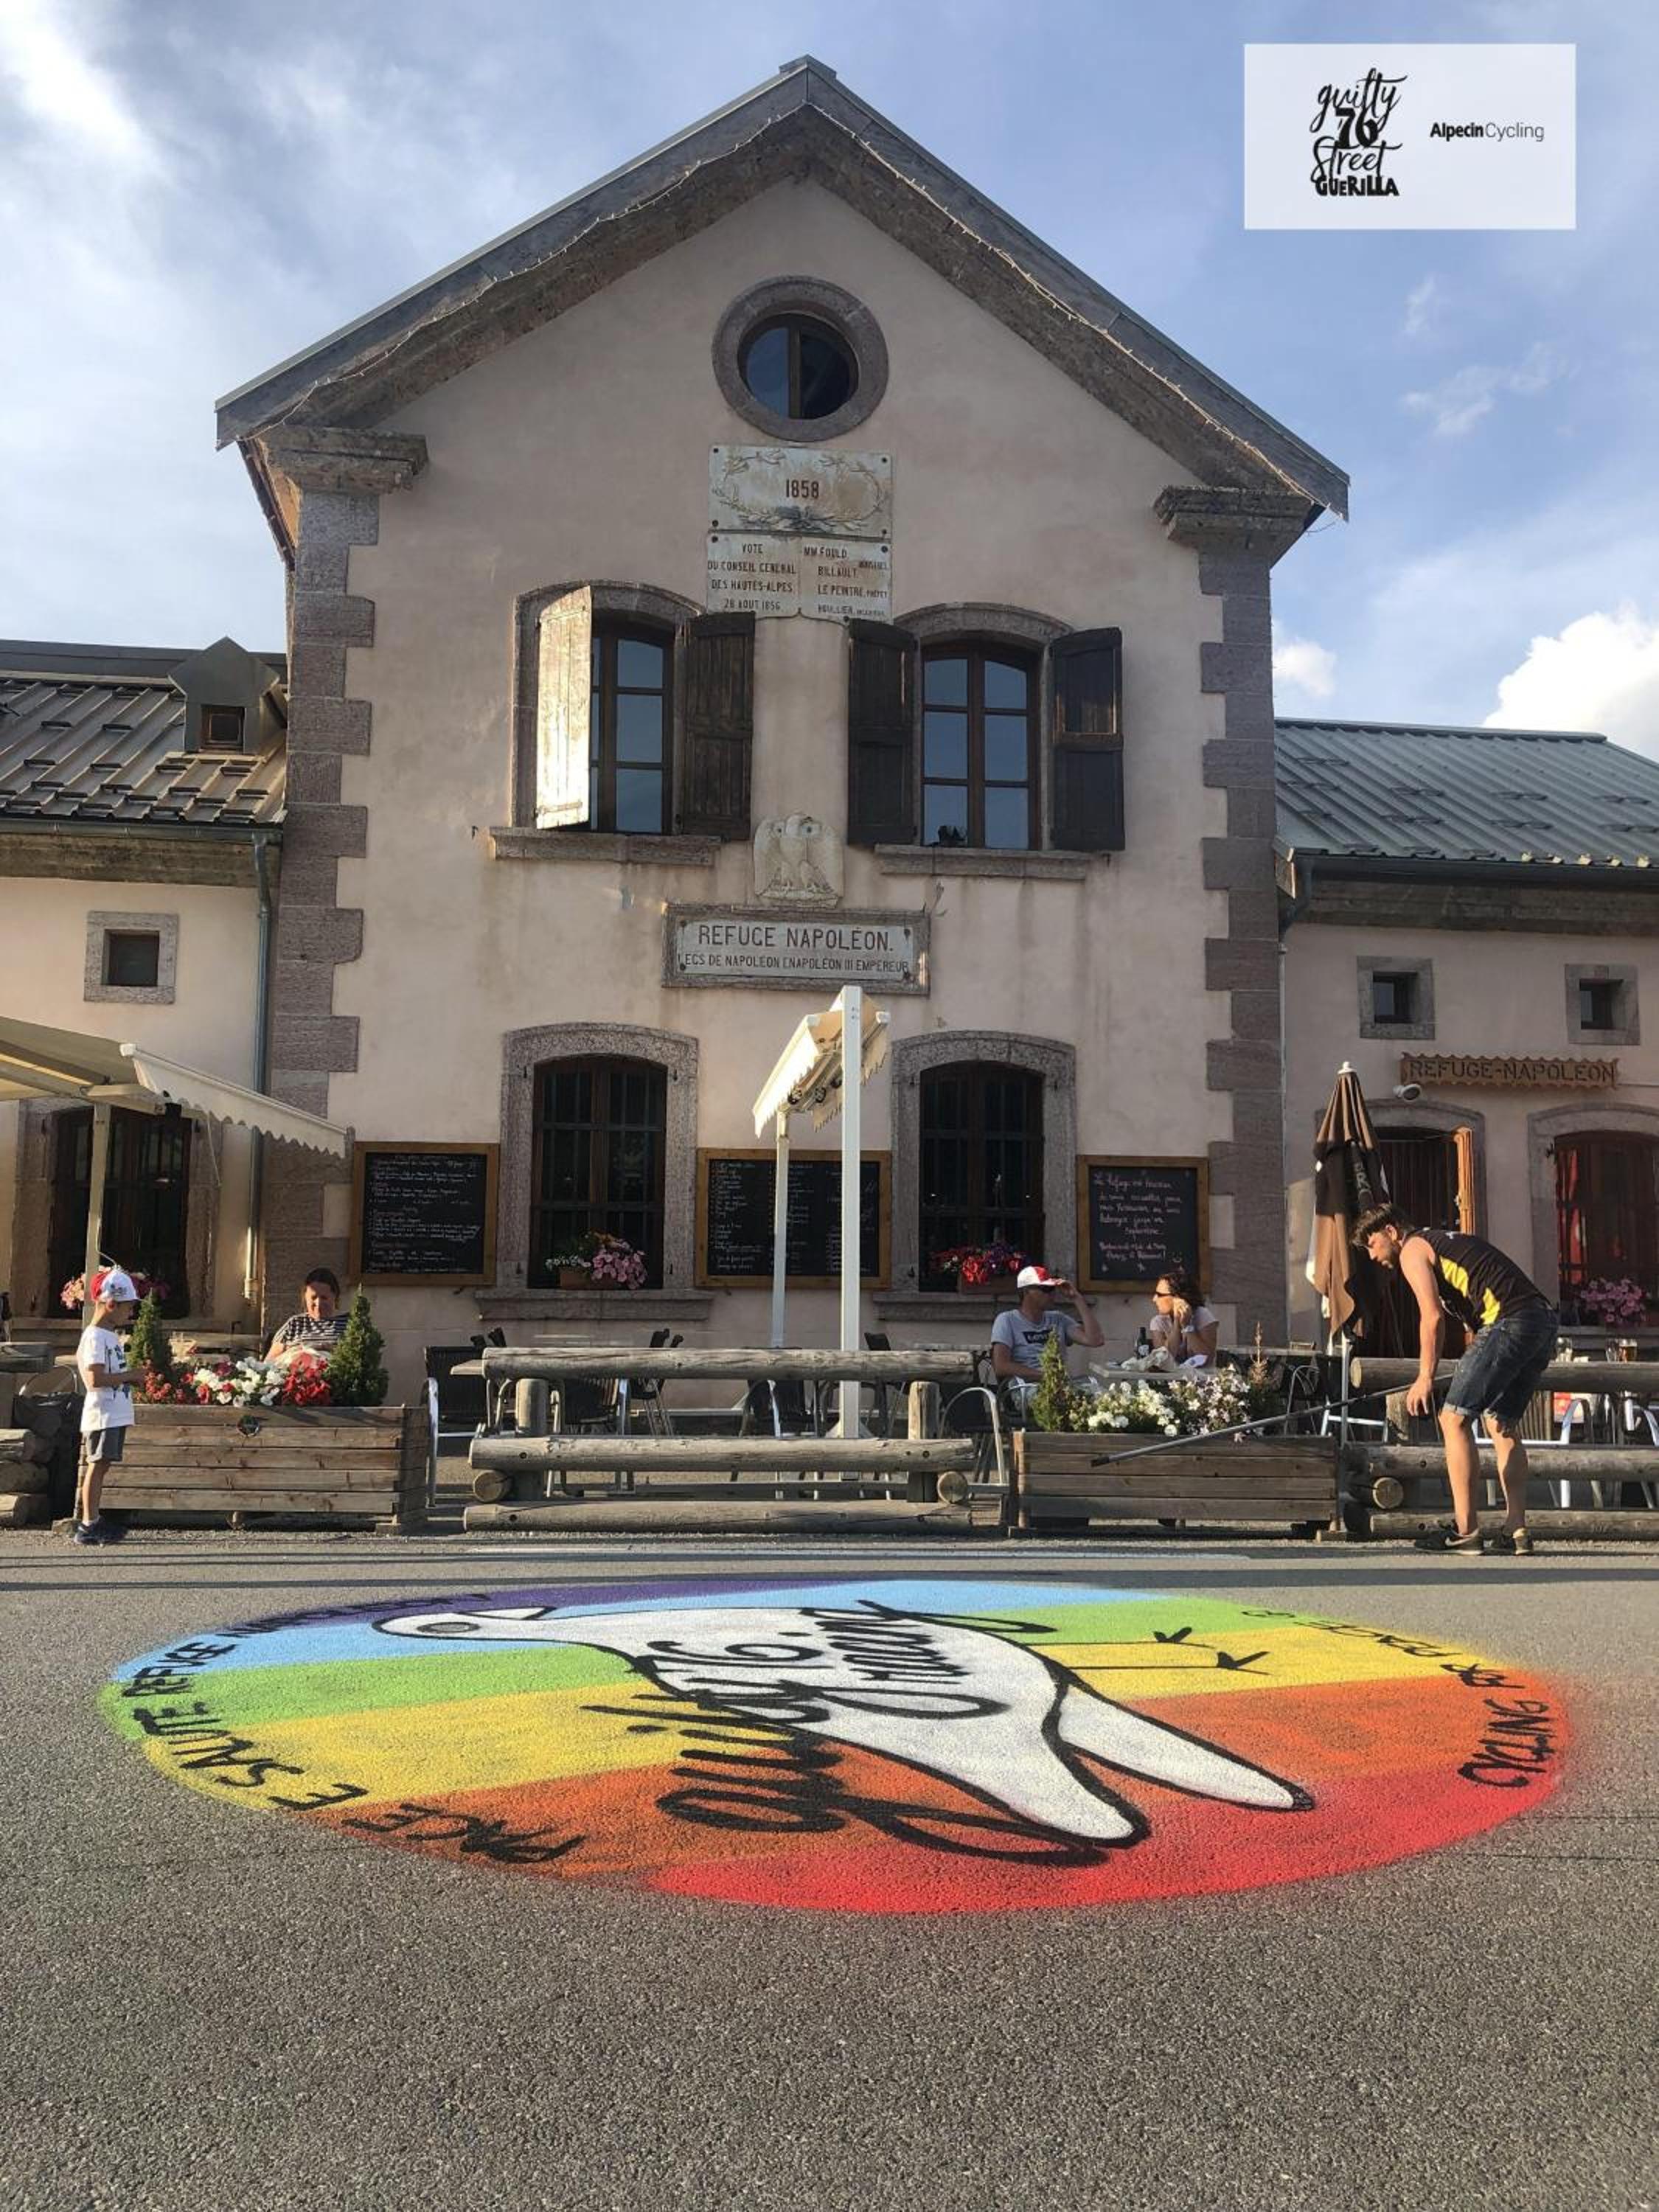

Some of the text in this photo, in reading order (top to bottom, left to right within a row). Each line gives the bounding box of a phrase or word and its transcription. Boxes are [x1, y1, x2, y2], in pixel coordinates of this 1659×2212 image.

[785, 479, 819, 499] 1858
[698, 925, 776, 947] REFUGE
[709, 955, 721, 967] DE
